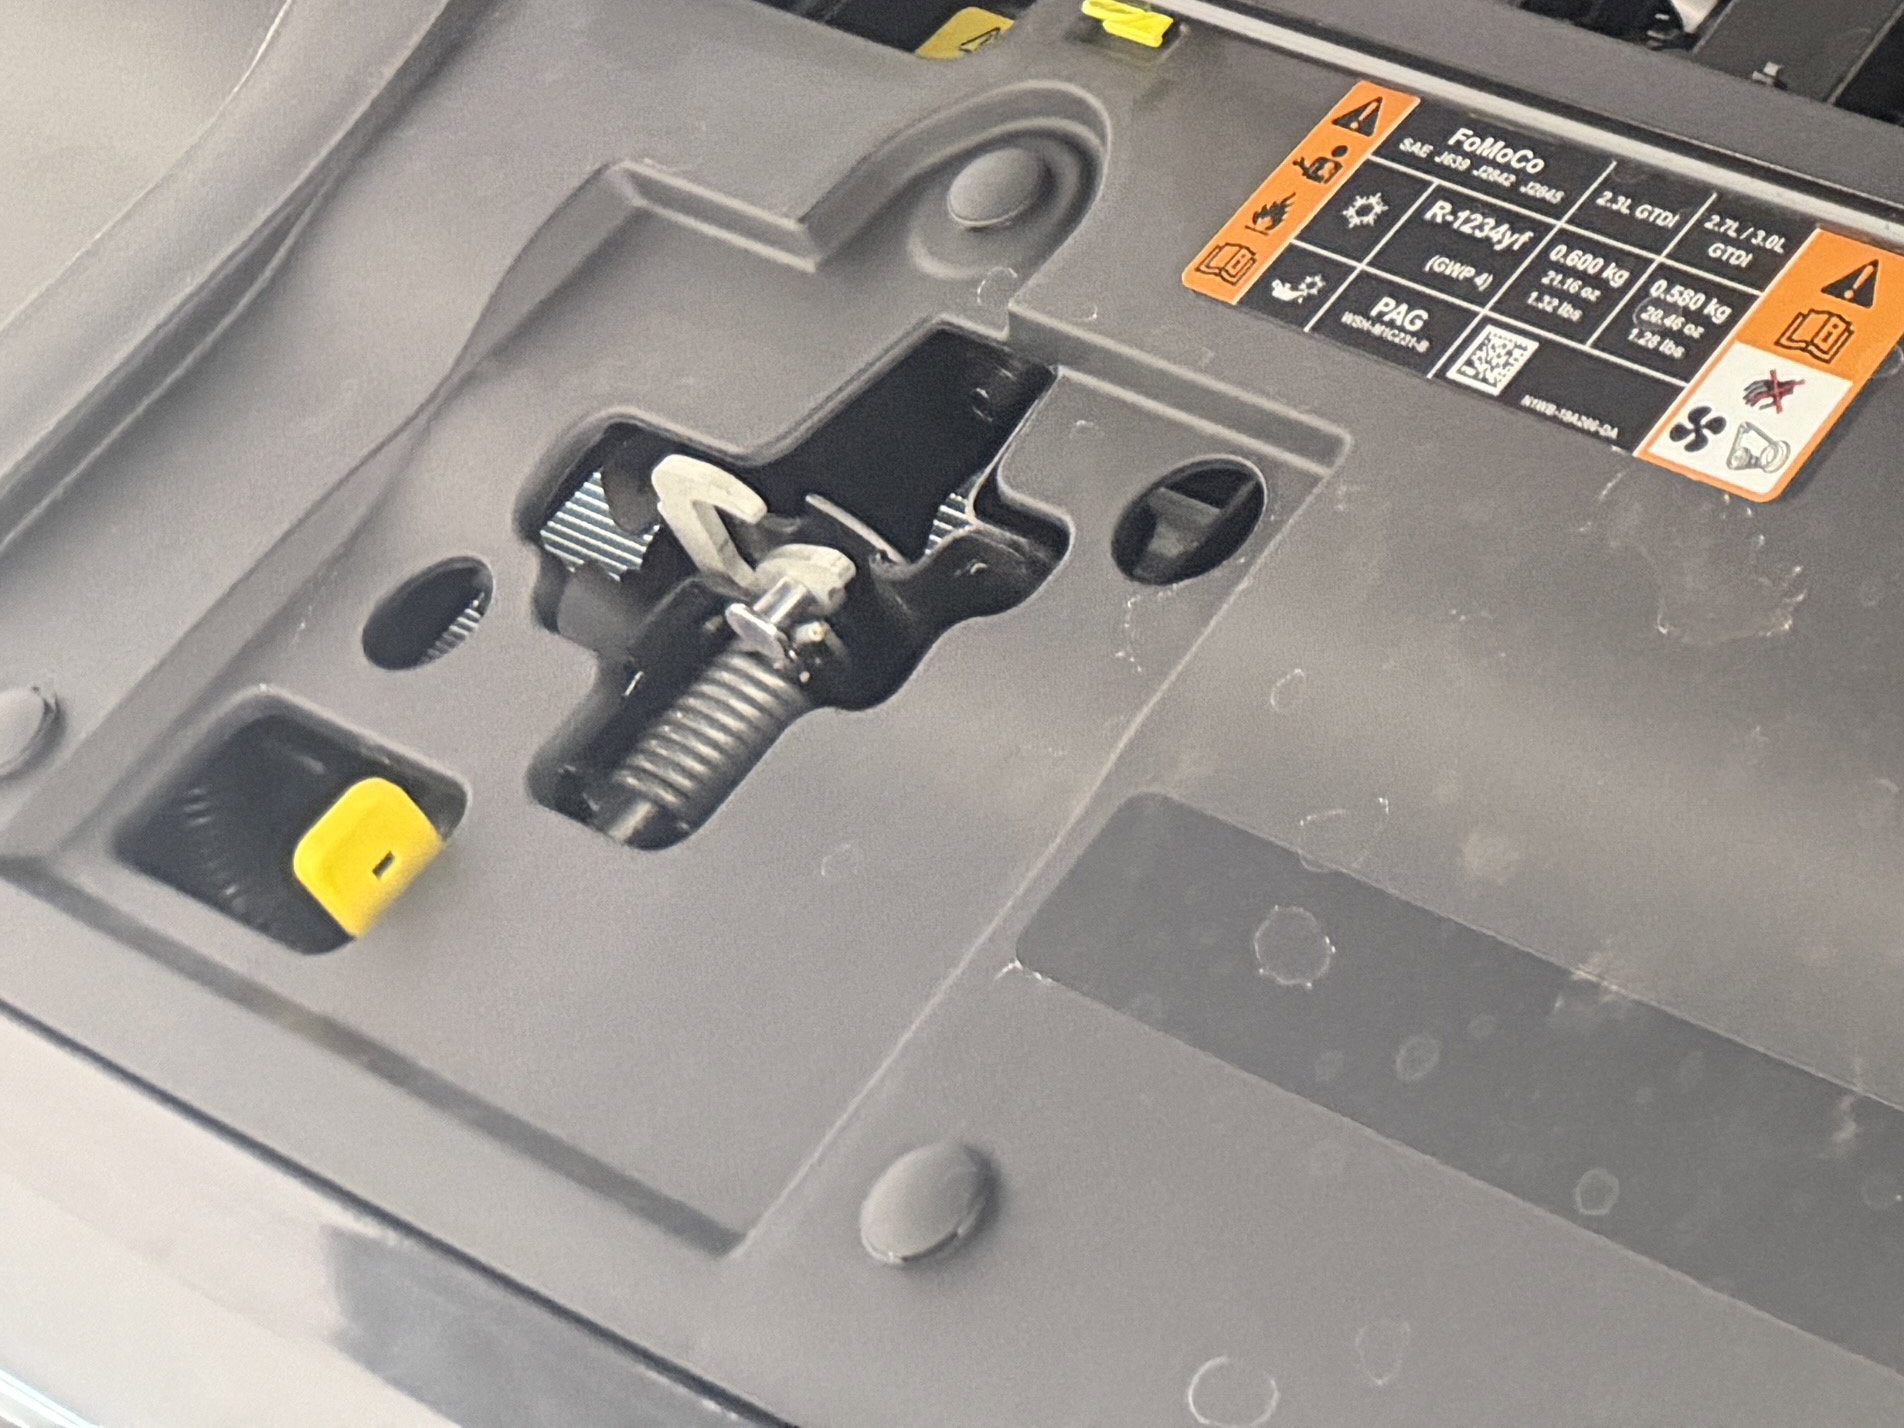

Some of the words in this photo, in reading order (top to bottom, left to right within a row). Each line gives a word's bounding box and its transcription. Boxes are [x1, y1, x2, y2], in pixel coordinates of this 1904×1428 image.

[1398, 137, 1434, 159] SAE
[1433, 150, 1472, 172] J639
[1447, 127, 1546, 175] FoMoCo
[1423, 198, 1535, 251] R-1234yf
[1594, 190, 1632, 215] 2.3L
[1634, 203, 1681, 230] GTDI
[1702, 213, 1739, 239] 2.7L
[1750, 229, 1787, 255] 3.0L
[1423, 254, 1477, 282] (GWP
[1473, 271, 1494, 292] 4)
[1548, 243, 1605, 276] 0.600
[1600, 260, 1631, 289] kg
[1707, 242, 1755, 269] GTDI
[1540, 269, 1583, 294] 21.16
[1579, 285, 1603, 303] oz
[1649, 278, 1707, 311] 0.580
[1702, 296, 1733, 325] kg
[1368, 296, 1430, 333] PAG
[1525, 290, 1560, 314] 1.32
[1556, 300, 1584, 323] lbs
[1639, 305, 1687, 332] 20.46
[1682, 322, 1706, 340] oz
[1658, 338, 1687, 360] lbs
